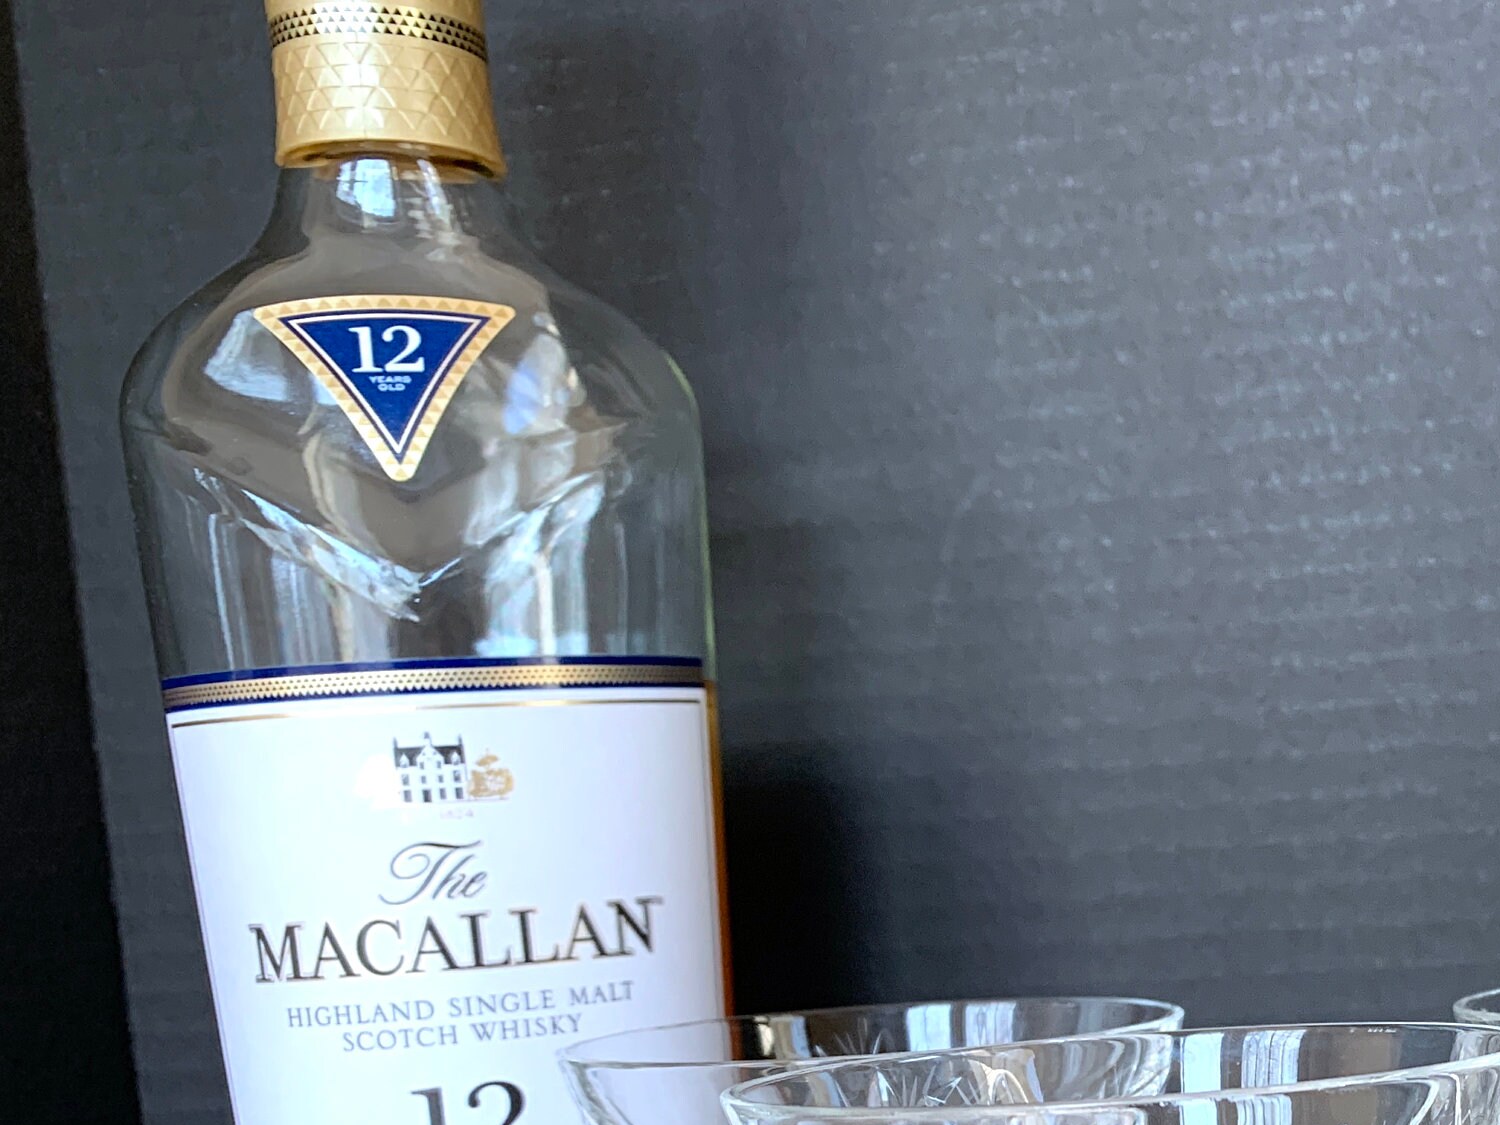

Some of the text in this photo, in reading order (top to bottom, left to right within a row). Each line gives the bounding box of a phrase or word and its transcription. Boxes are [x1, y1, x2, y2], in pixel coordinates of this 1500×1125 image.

[348, 325, 425, 373] 12
[369, 375, 412, 384] YEARS
[377, 383, 406, 392] OLD
[378, 840, 488, 905] The
[248, 895, 664, 983] MACALLAN
[286, 980, 635, 1027] HIGHLAND SINGLE MALT
[342, 1012, 584, 1053] SCOTCH WHISKY
